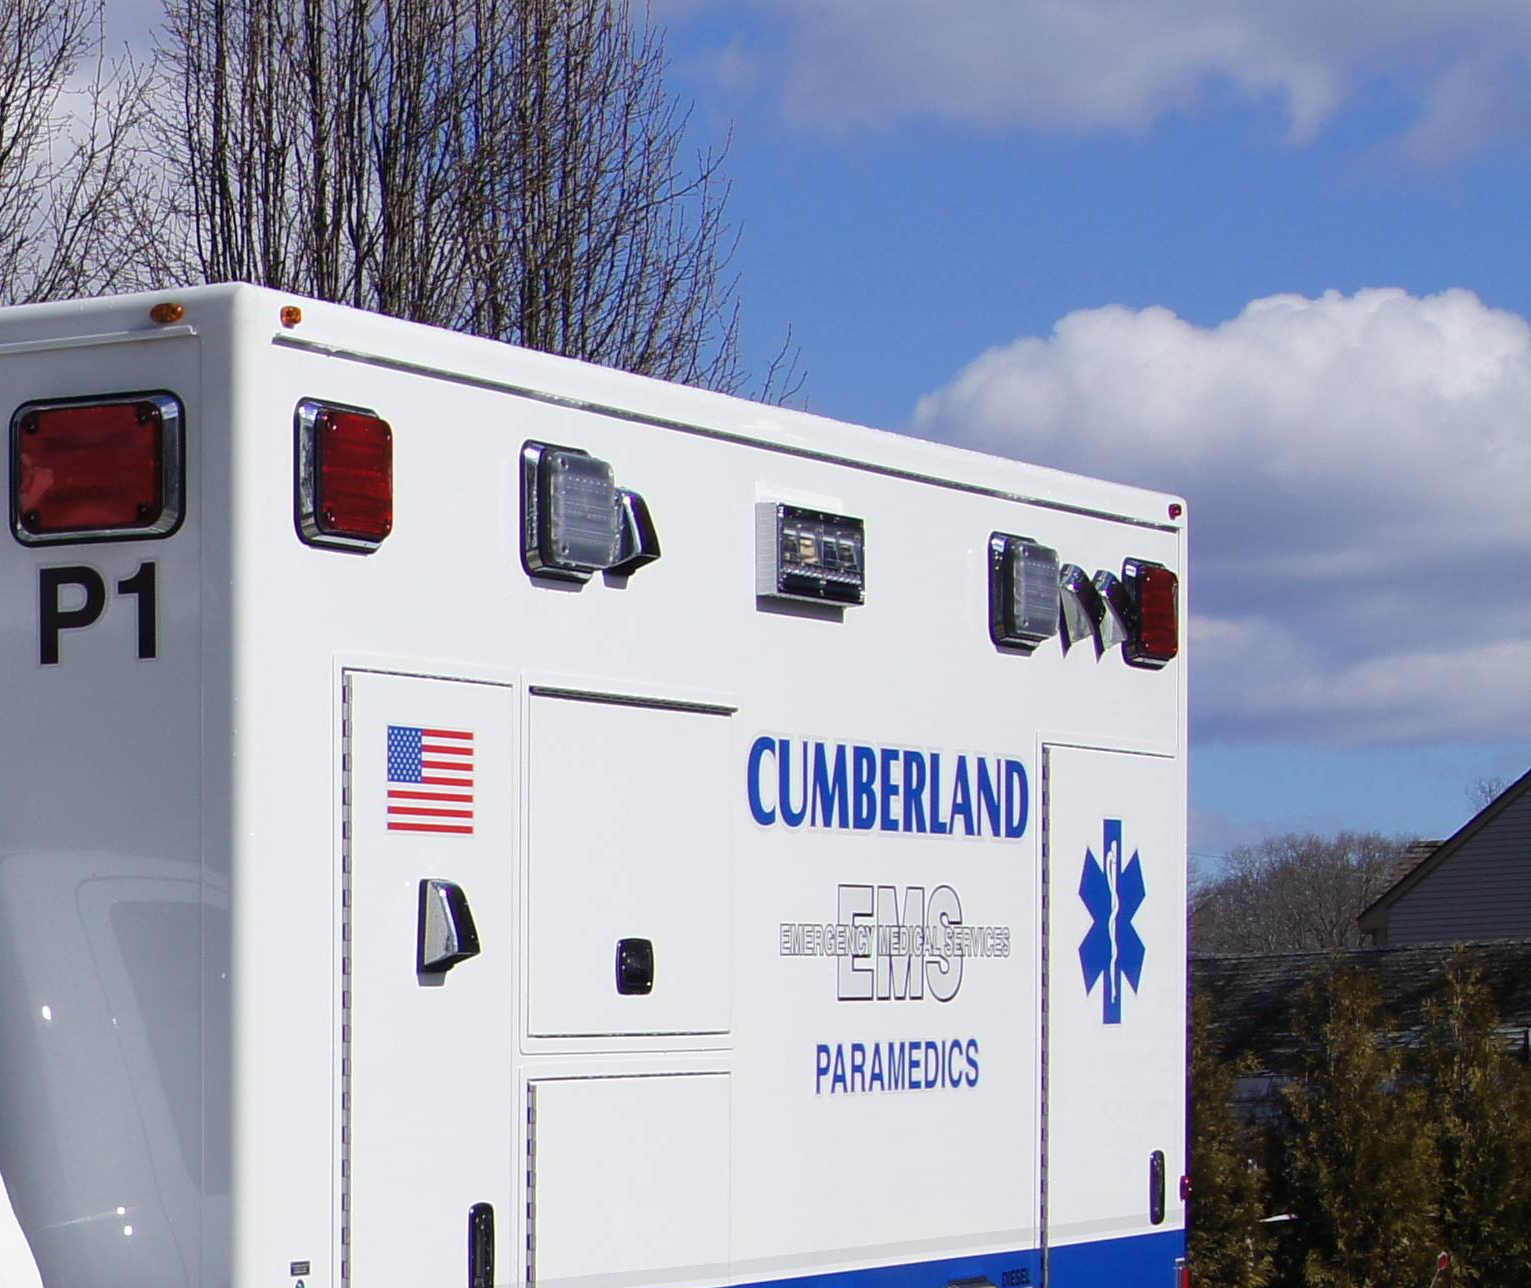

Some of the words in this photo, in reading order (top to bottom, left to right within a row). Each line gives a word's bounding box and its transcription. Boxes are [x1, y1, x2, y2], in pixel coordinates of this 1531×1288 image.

[39, 562, 156, 665] P1
[746, 735, 1030, 839] CUMBERLAND
[779, 922, 875, 957] EMERGENCY
[878, 924, 942, 957] MEDICAL
[943, 926, 1012, 958] SERVICES
[836, 884, 964, 1003] EMS
[814, 1038, 980, 1096] PARAMEDICS
[1001, 1268, 1031, 1288] DIESEL
